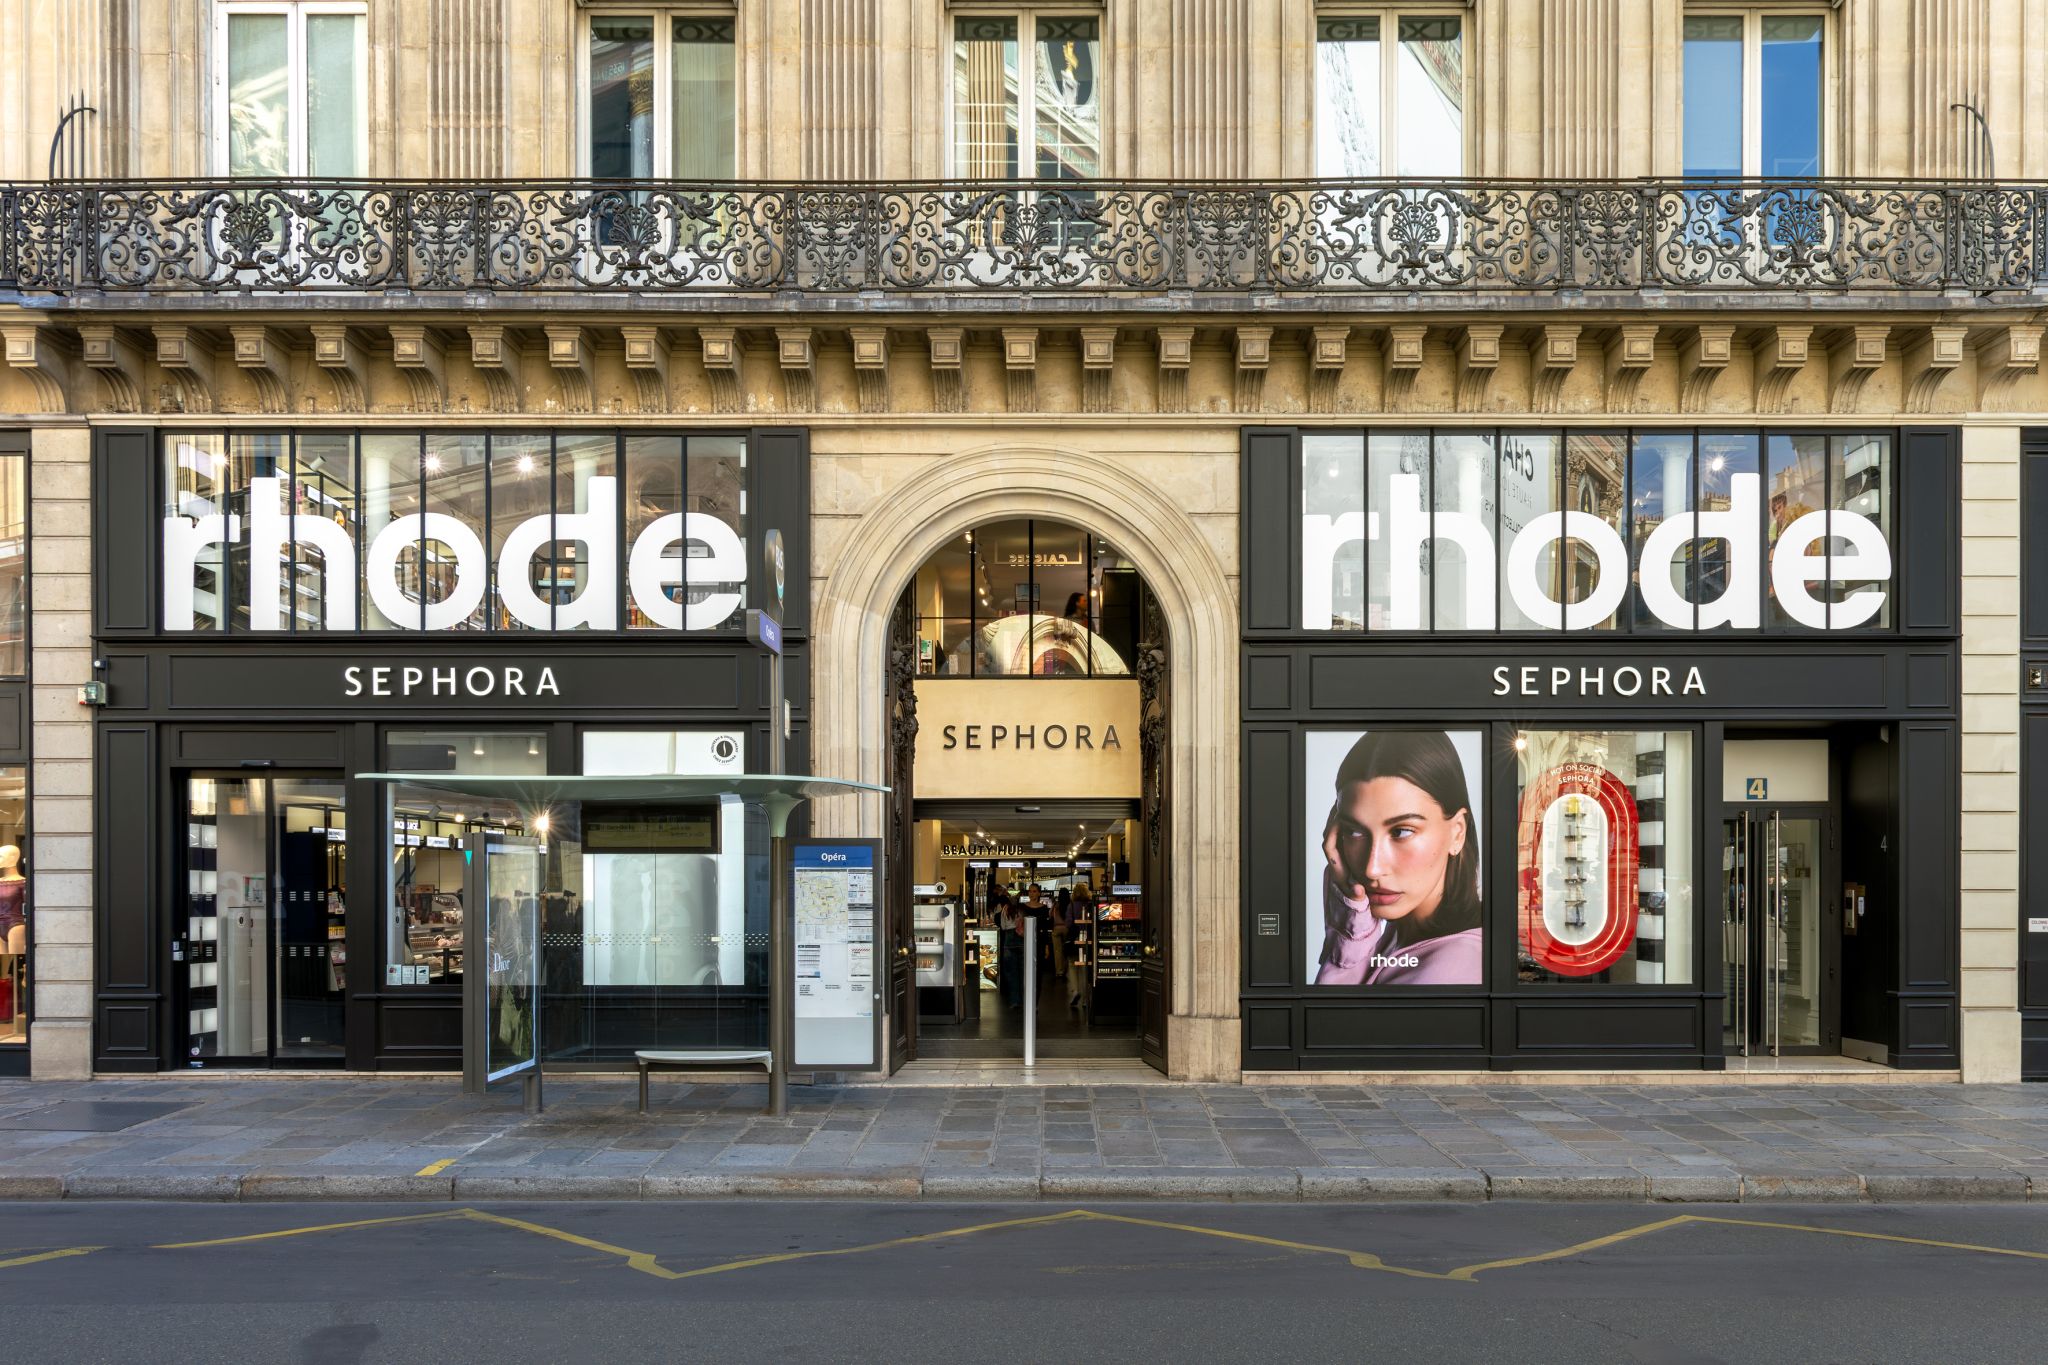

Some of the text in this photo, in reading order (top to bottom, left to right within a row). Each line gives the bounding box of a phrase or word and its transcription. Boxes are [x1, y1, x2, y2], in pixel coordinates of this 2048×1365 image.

[622, 24, 731, 40] GOX
[1326, 22, 1434, 38] GEX
[164, 476, 747, 631] rhode
[1302, 474, 1892, 630] rhode
[343, 666, 560, 697] SEPHORA
[1492, 665, 1708, 697] SEPHORA
[943, 724, 1122, 750] SEPHORA
[1579, 764, 1603, 776] SOCIAL
[1558, 775, 1594, 785] SEPHORA
[1748, 778, 1766, 799] 4
[943, 845, 1024, 856] BEAUTY HUB
[1880, 835, 1888, 852] 4
[821, 852, 847, 863] Opéra
[493, 952, 510, 972] Dior
[1370, 953, 1419, 968] rhode
